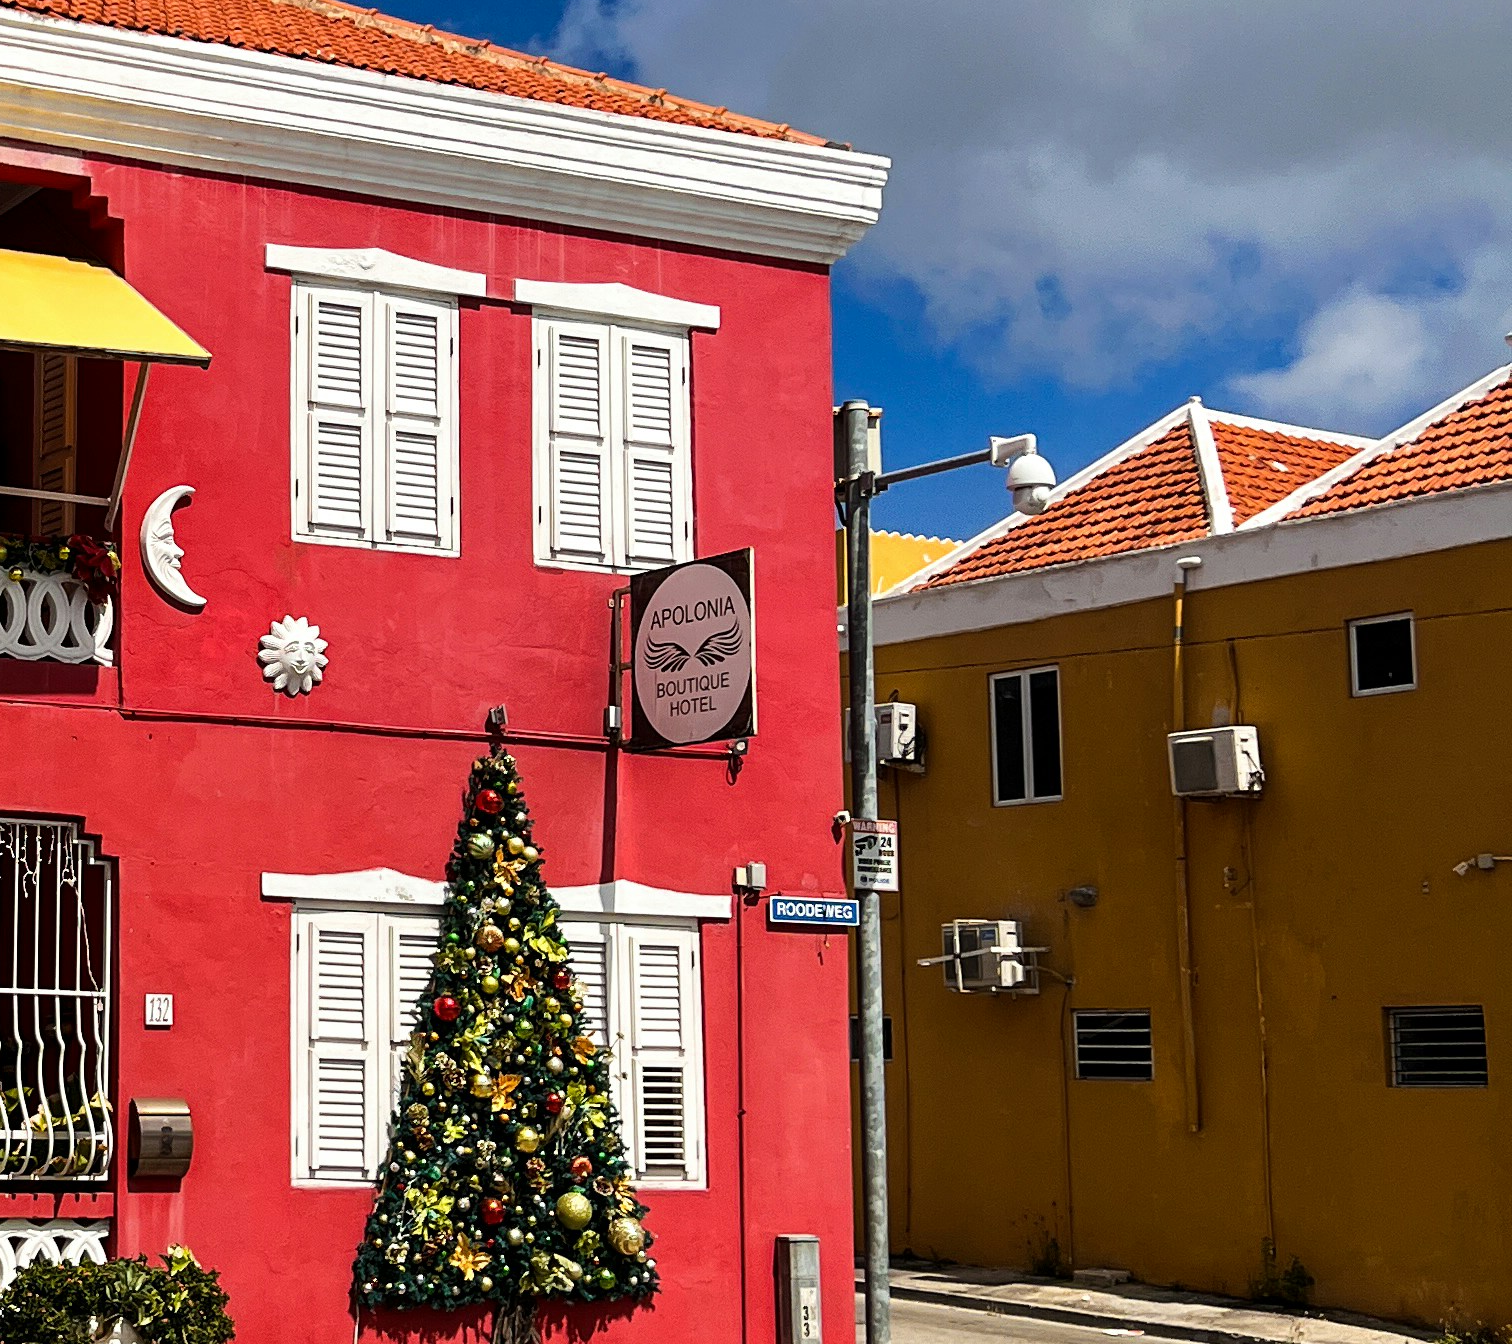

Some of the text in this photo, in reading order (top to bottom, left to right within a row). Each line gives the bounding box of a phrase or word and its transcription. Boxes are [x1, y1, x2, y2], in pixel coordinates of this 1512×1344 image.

[650, 595, 736, 630] APOLONIA
[656, 671, 730, 698] BOUTIQUE
[669, 695, 717, 717] HOTEL
[852, 821, 896, 834] WARNING
[880, 836, 892, 848] 24
[776, 901, 853, 920] ROODEWEG
[148, 997, 170, 1022] 132
